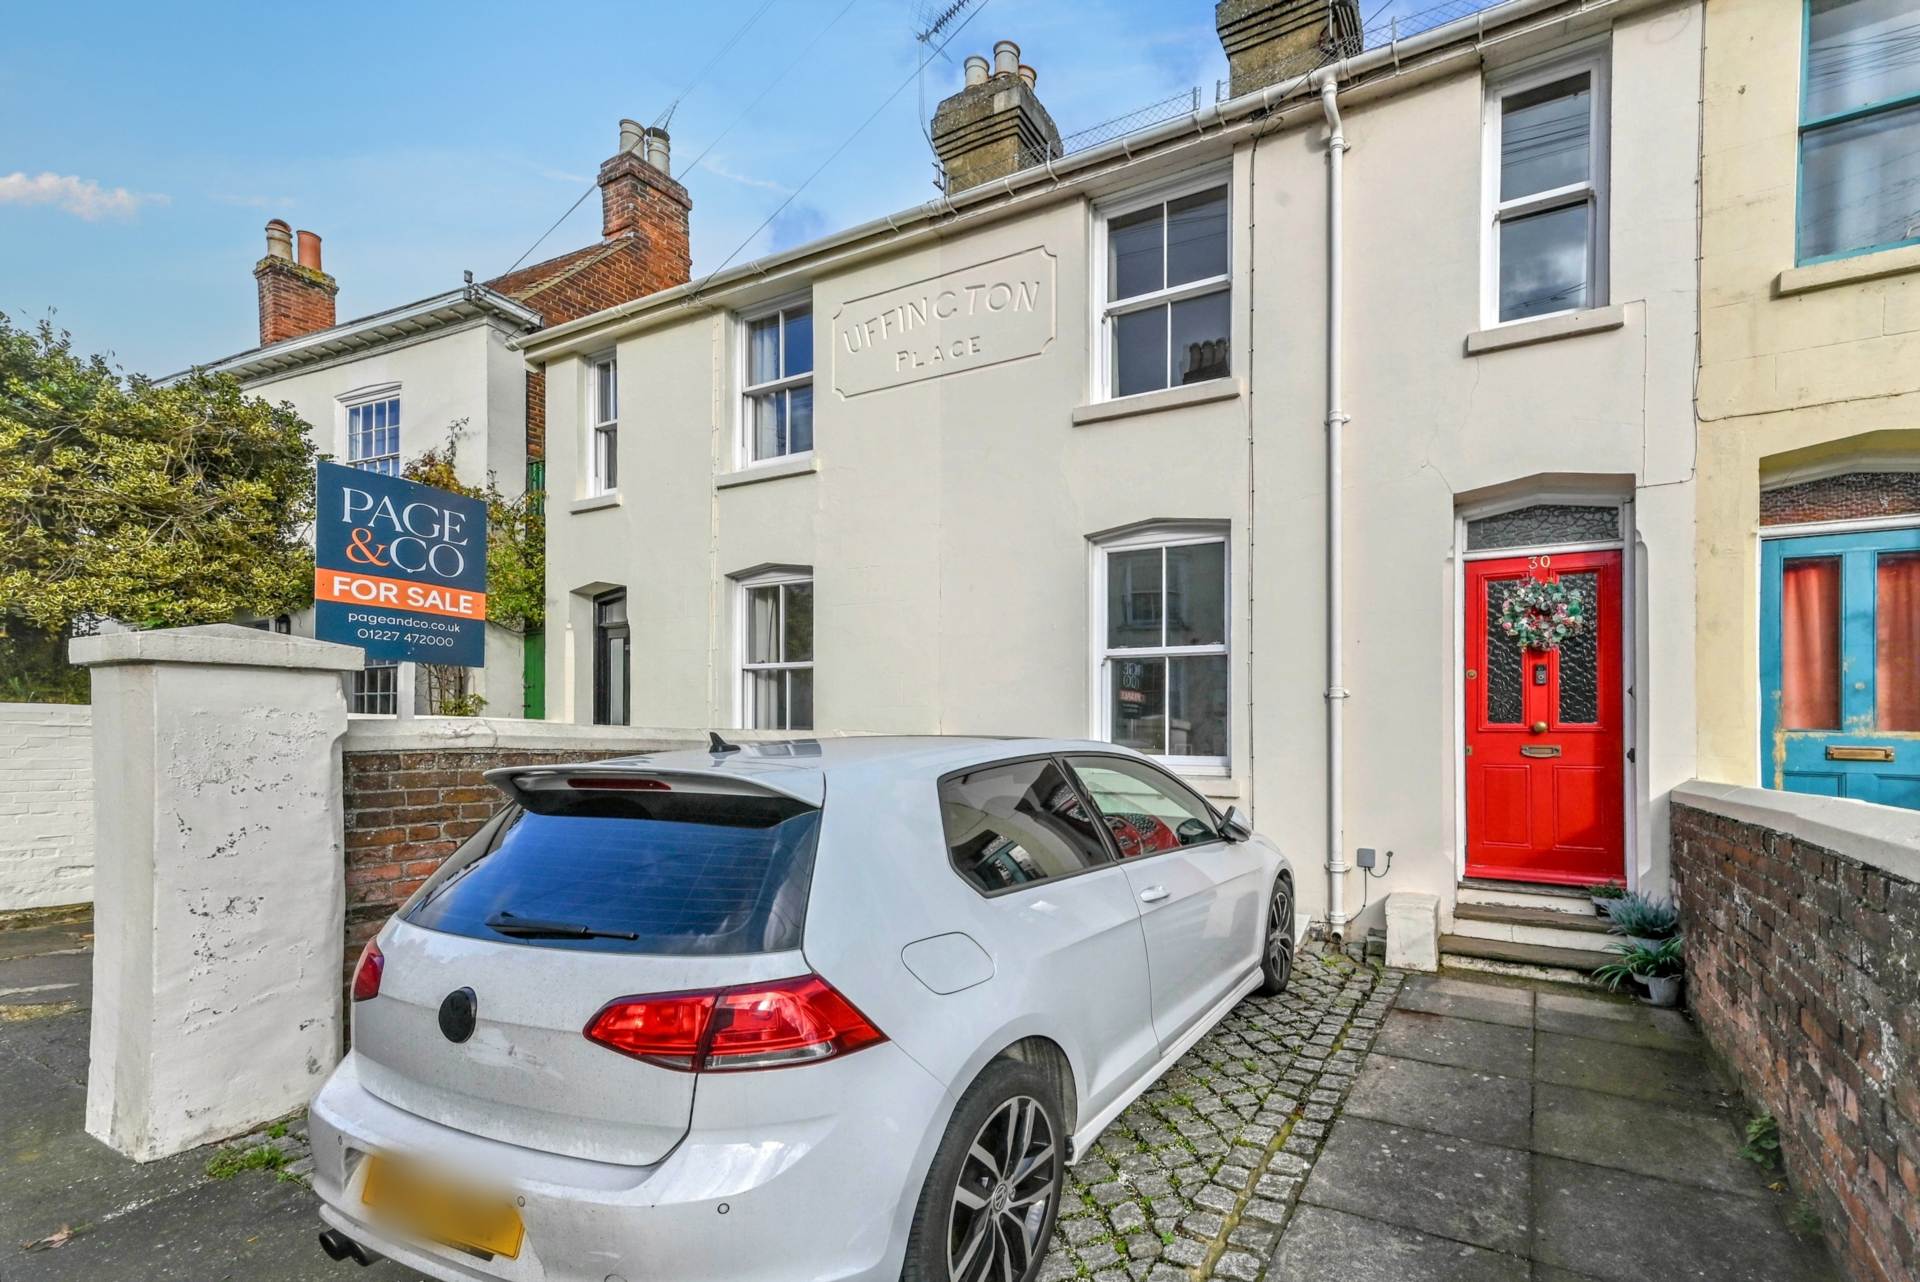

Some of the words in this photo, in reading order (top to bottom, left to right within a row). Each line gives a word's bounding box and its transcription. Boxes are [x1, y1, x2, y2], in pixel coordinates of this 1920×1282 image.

[842, 281, 1040, 353] UFFINGTON
[895, 335, 980, 372] PLACE
[341, 486, 468, 547] PAGE
[1527, 555, 1551, 569] 30
[333, 575, 399, 604] FOR
[406, 586, 473, 614] SALE
[348, 612, 460, 633] pageandco.co.uk
[357, 628, 400, 642] 01227
[404, 633, 454, 648] 472000
